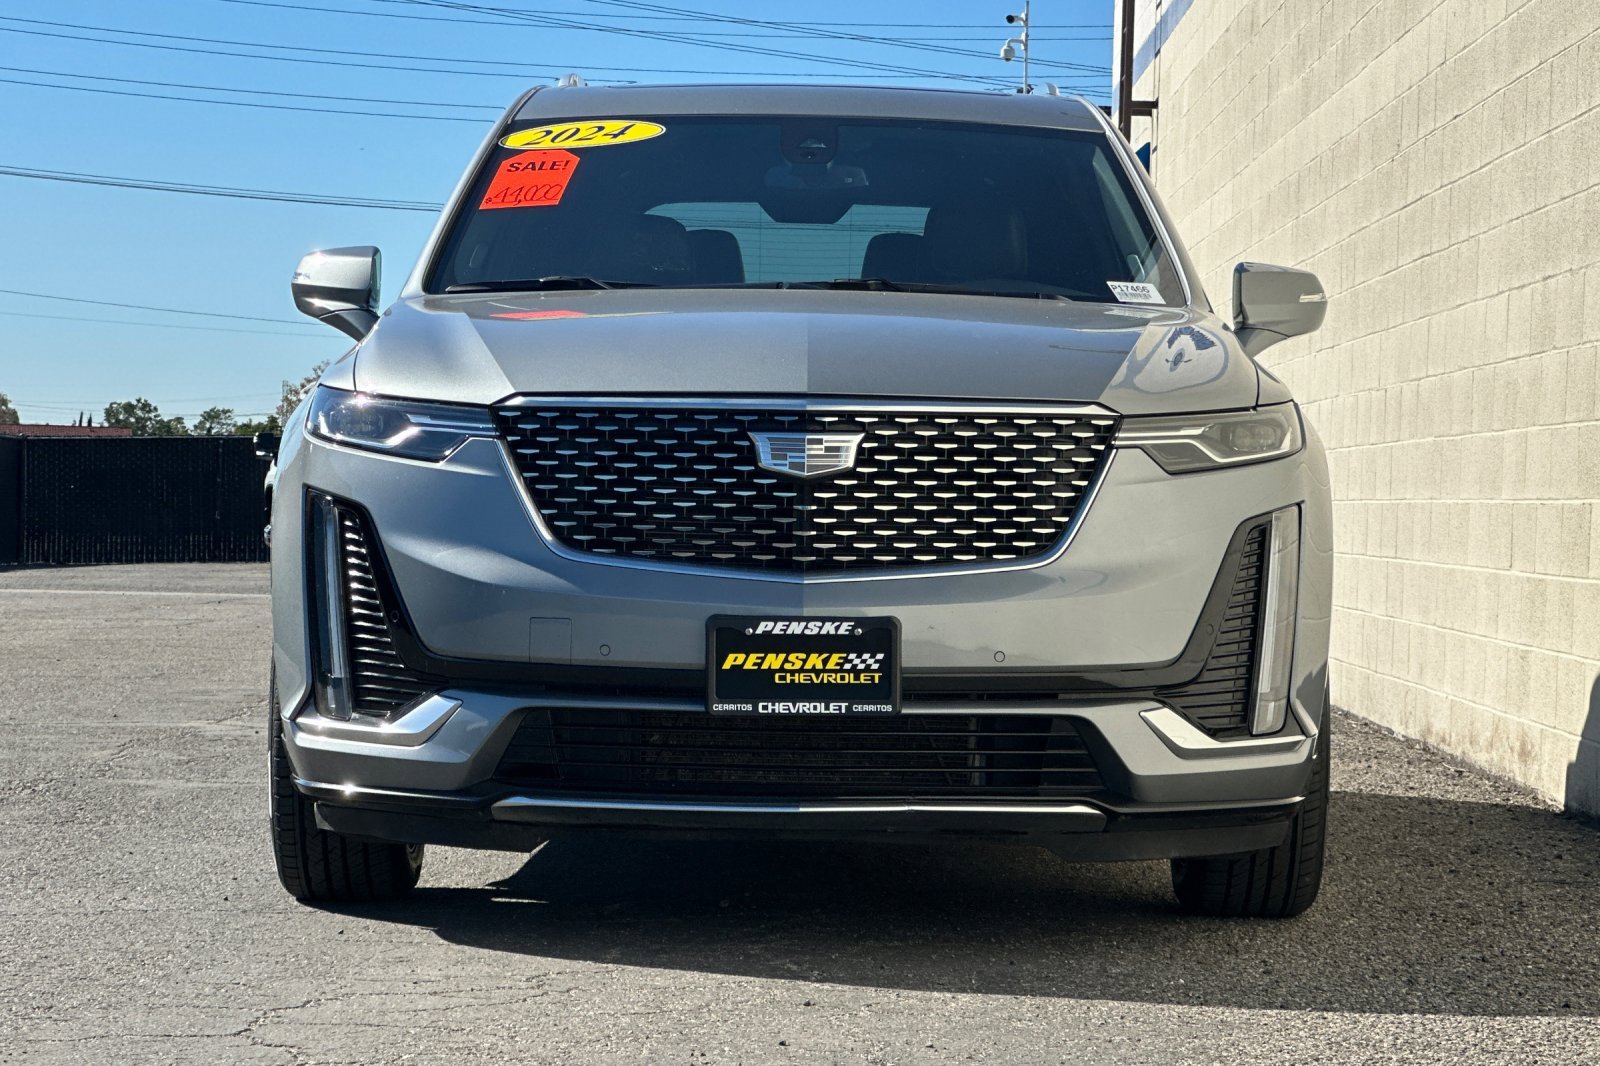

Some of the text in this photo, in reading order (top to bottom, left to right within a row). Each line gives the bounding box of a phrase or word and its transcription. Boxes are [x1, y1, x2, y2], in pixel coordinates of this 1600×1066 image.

[521, 123, 636, 146] 2024
[507, 160, 570, 172] SALE!
[755, 621, 854, 635] PENSKE
[722, 653, 847, 670] PENSKE
[775, 672, 882, 684] CHEVROLET
[713, 702, 892, 714] CERRITOS CHEVROLET CERRITOS
